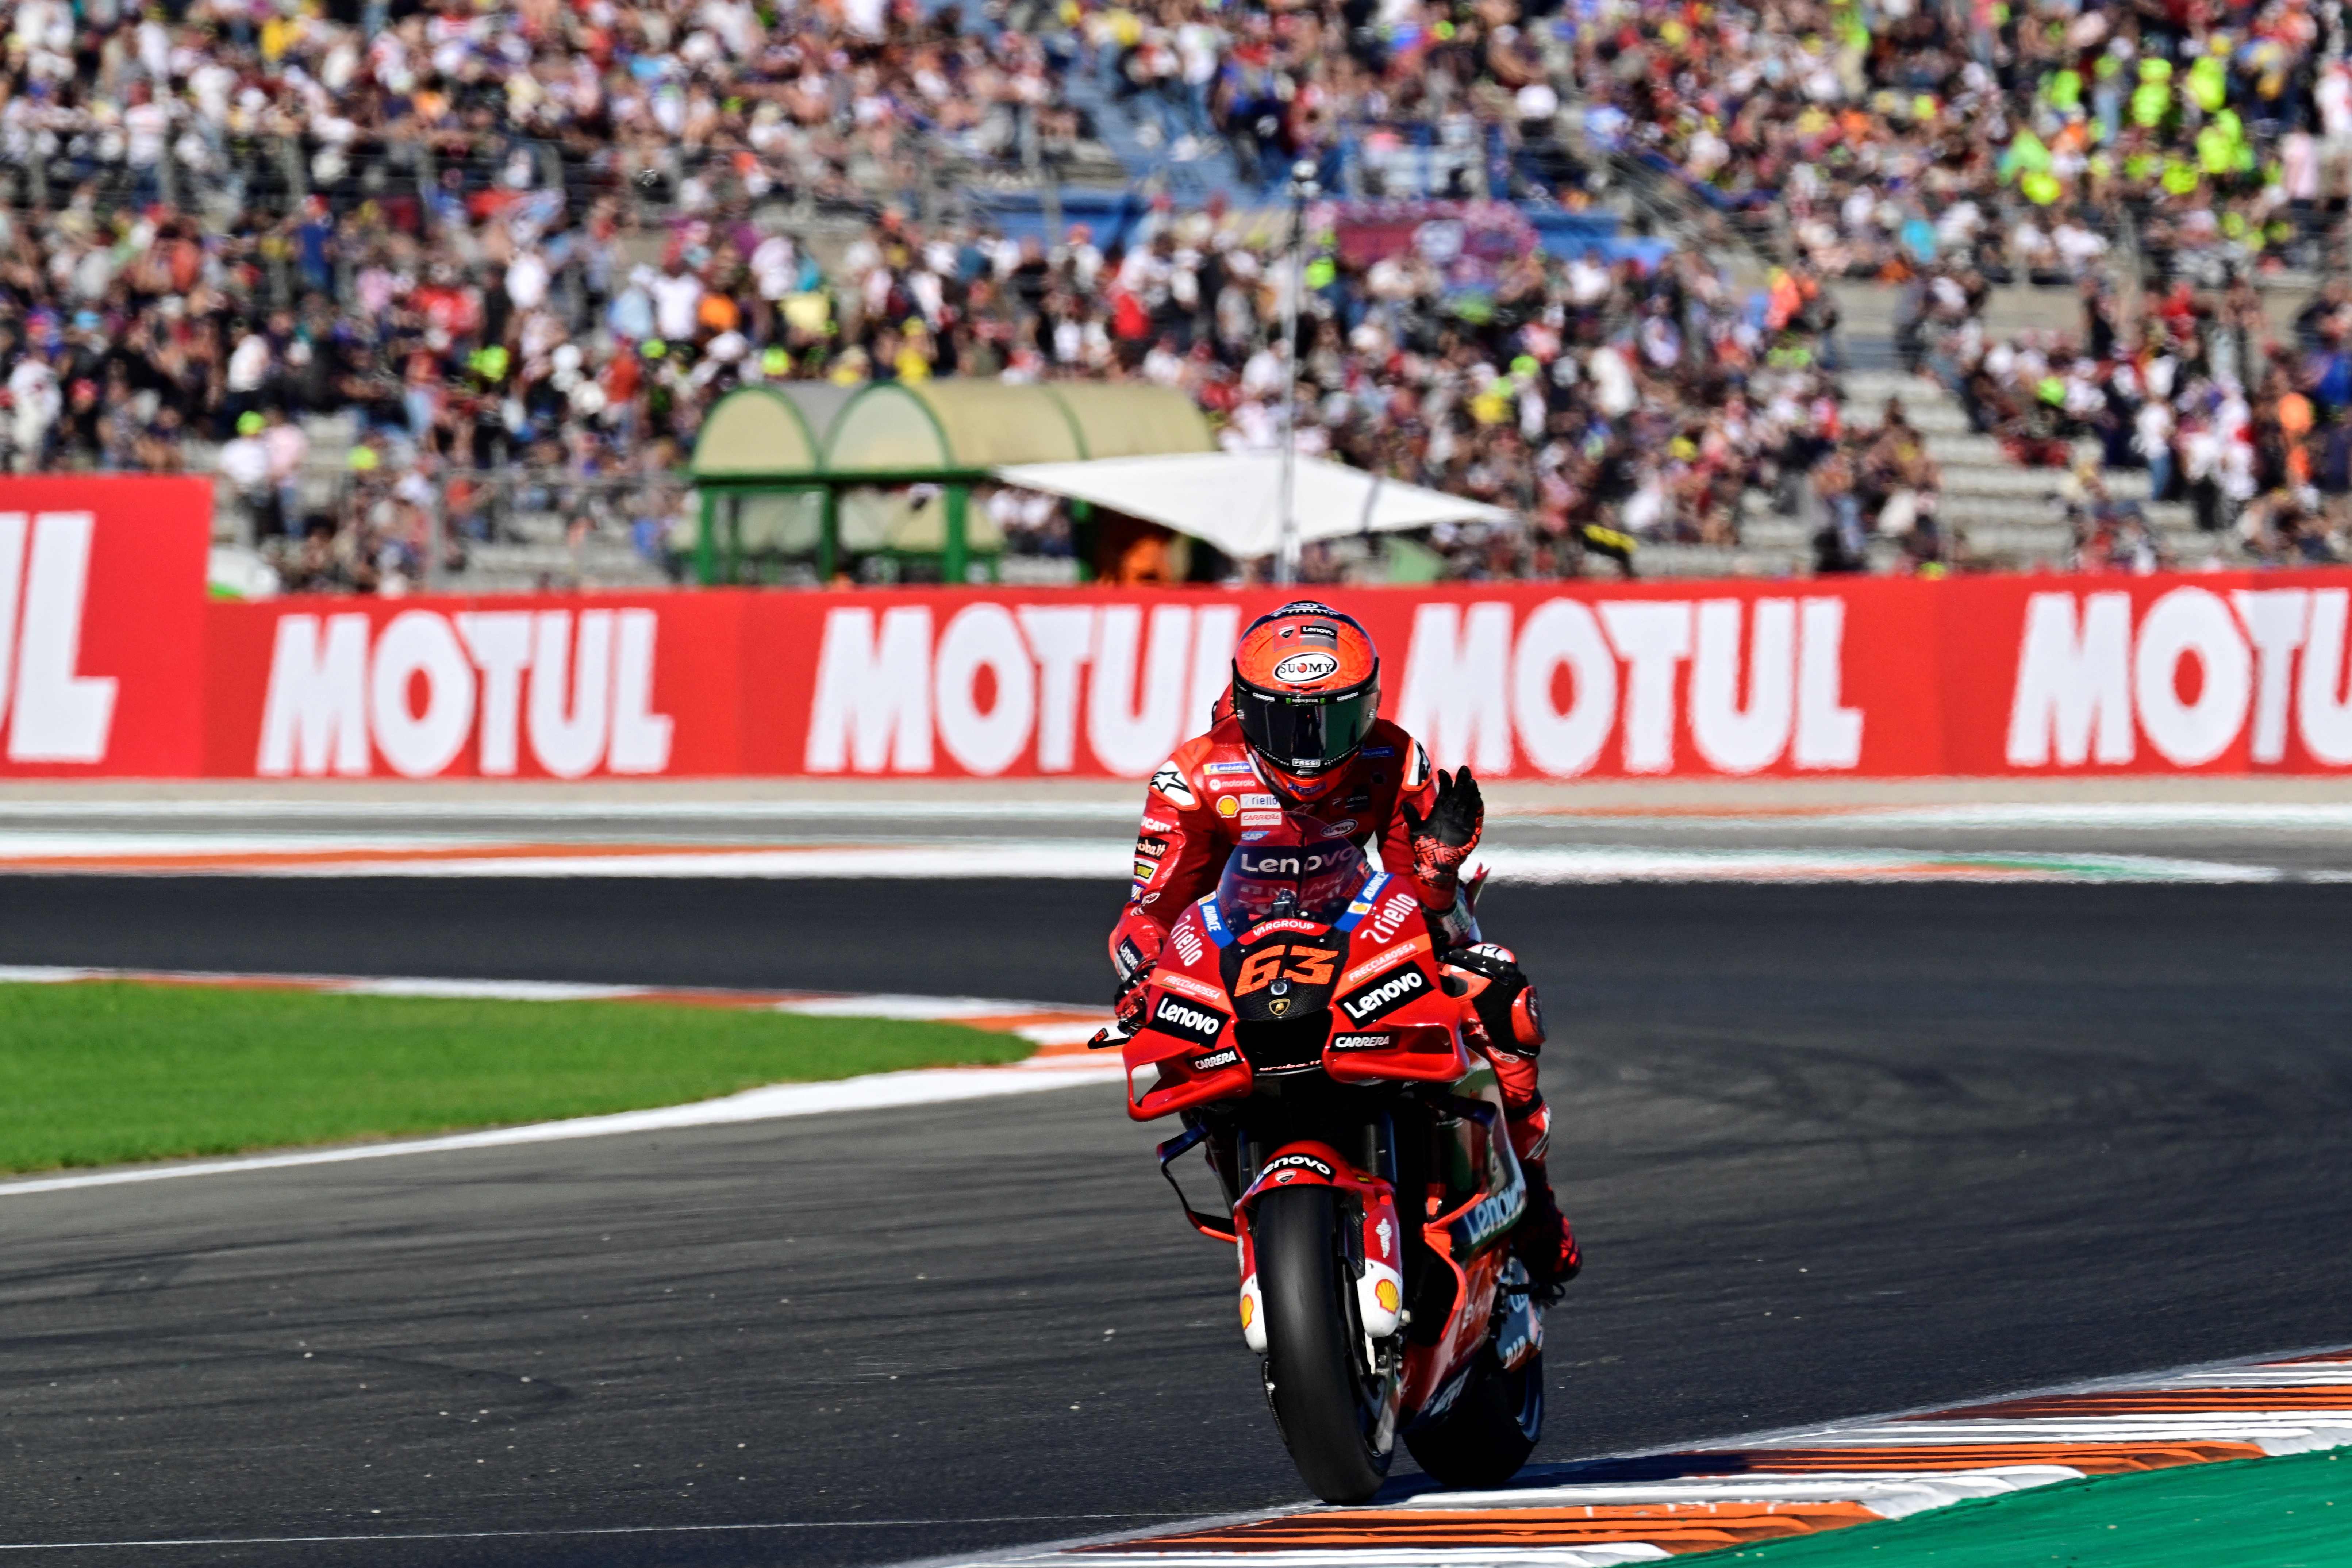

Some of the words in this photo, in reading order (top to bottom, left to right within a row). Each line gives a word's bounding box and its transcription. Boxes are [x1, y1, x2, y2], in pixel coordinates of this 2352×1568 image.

[1302, 626, 1334, 636] Lenovo
[1279, 662, 1332, 673] SUOMY
[258, 609, 673, 777] MOTUL
[1394, 597, 1864, 776] MOTUL
[1221, 779, 1256, 787] motorola
[1241, 846, 1354, 875] Lenovo
[1362, 871, 1389, 901] ADVANCE
[1202, 905, 1222, 932] ADVANCE
[1253, 920, 1315, 936] VARGROUP
[1119, 940, 1138, 970] Lenovo
[1348, 943, 1417, 982] FRECCIAROSSA
[1234, 944, 1339, 997] 63
[1162, 975, 1221, 999] FRECCIAROSSA
[1343, 972, 1422, 1019] Lenovo
[1157, 997, 1219, 1035] Lenovo
[1336, 1035, 1390, 1048] CARRERA
[1195, 1050, 1237, 1069] CARRERA
[1259, 1059, 1322, 1071] aruba.it
[1254, 1156, 1331, 1185] Lenovo
